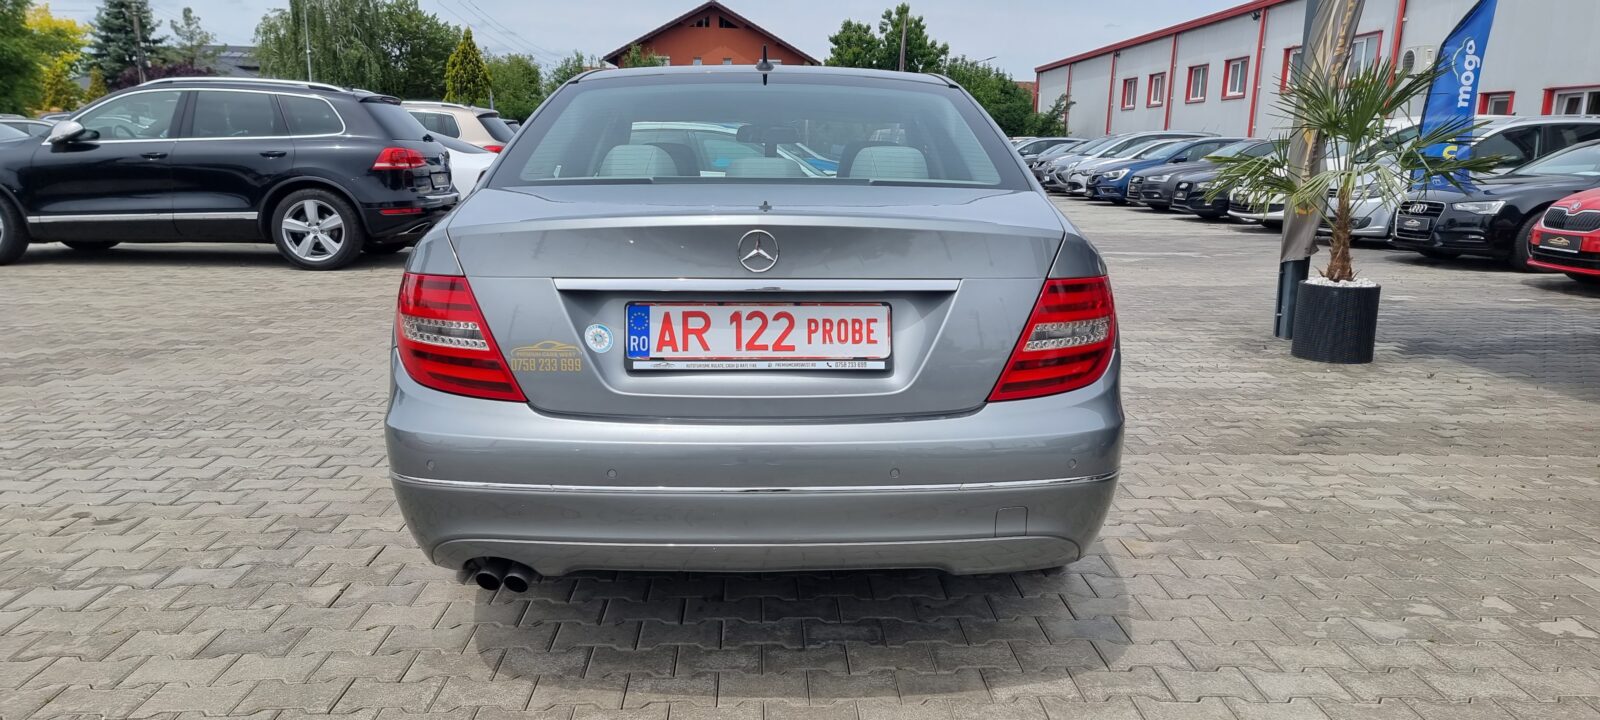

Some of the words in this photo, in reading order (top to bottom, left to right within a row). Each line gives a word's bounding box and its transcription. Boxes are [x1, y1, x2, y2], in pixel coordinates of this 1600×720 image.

[1457, 40, 1480, 108] mogo
[630, 335, 648, 352] RO
[656, 310, 712, 353] AR
[729, 310, 796, 352] 122
[807, 318, 878, 345] PROBE
[511, 358, 537, 372] 0758
[539, 358, 558, 372] 233
[560, 358, 582, 372] 699
